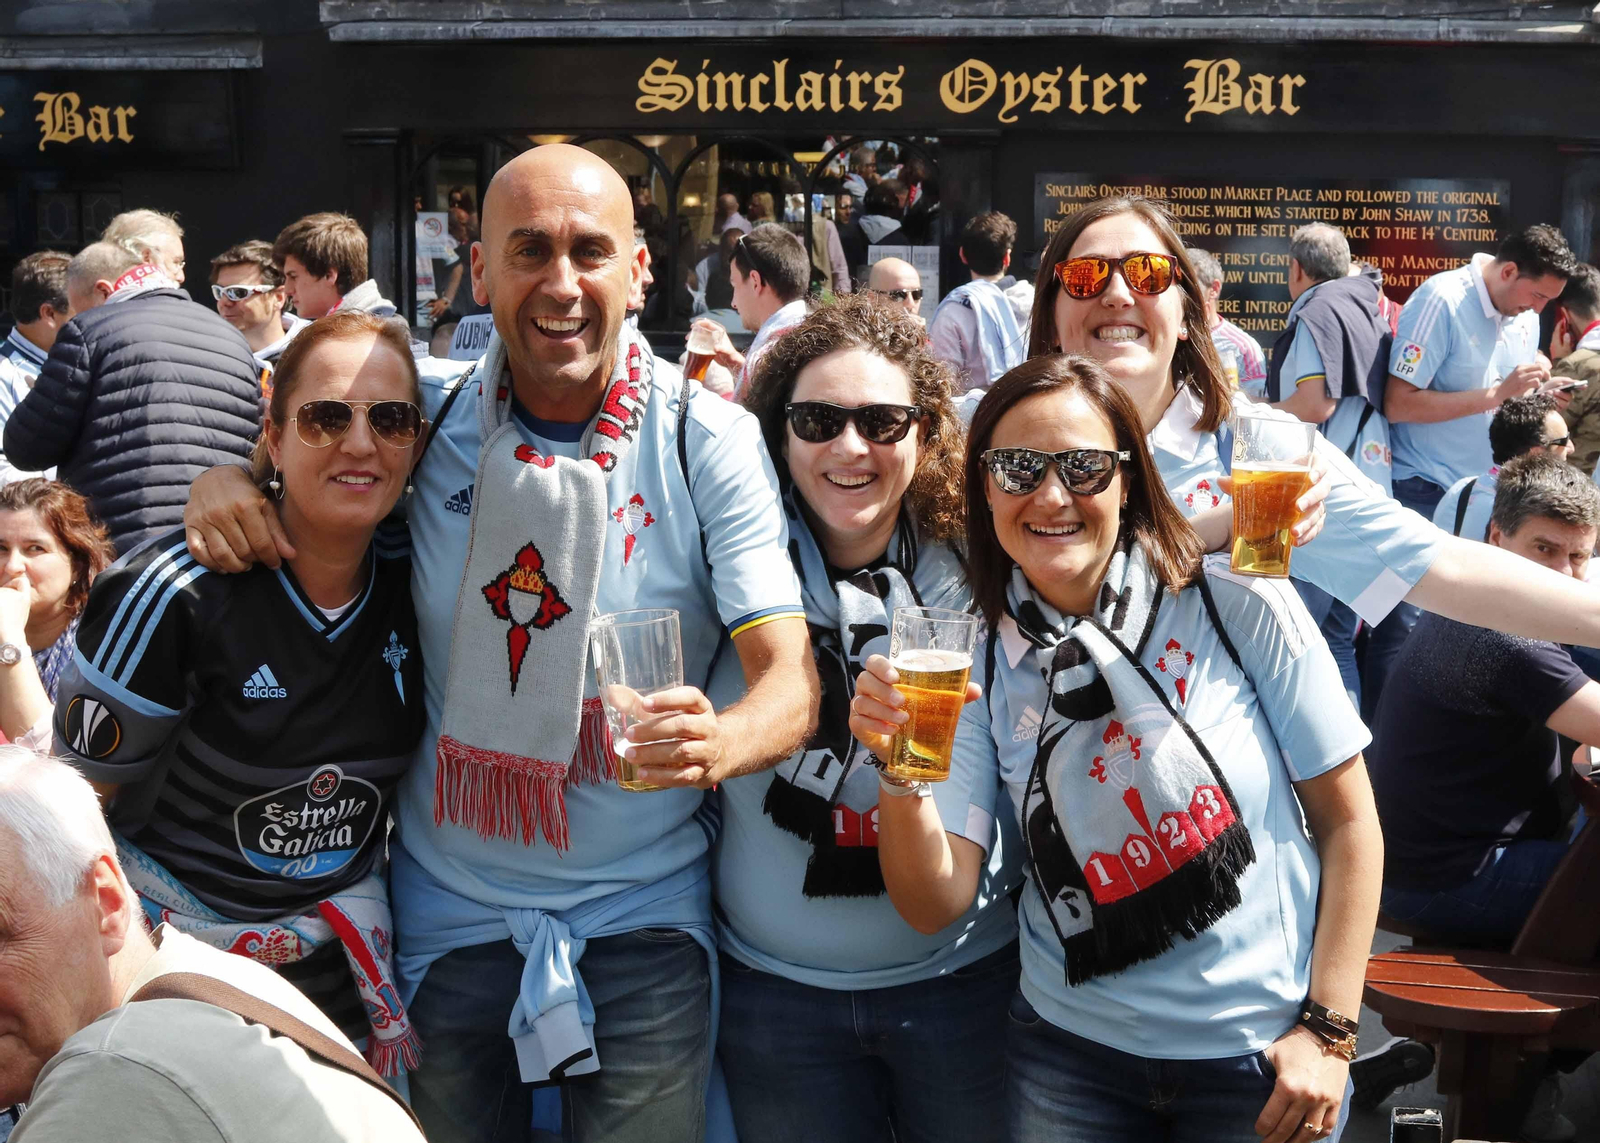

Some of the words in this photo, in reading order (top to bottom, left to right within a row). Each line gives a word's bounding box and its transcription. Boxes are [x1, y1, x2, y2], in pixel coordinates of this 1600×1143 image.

[635, 57, 905, 113] Sinclairs
[939, 58, 1148, 124] Oyster
[1183, 57, 1307, 124] Bar
[33, 91, 138, 152] Bar
[1099, 184, 1142, 199] OYSTER
[1144, 184, 1168, 199] BAR
[1171, 186, 1207, 200] STOOD
[1210, 187, 1222, 200] IN
[1224, 185, 1273, 201] MARKET
[1276, 186, 1313, 201] PLACE
[1316, 189, 1342, 202] AND
[1345, 190, 1411, 204] FOLLOWED
[1416, 190, 1439, 205] THE
[1443, 191, 1501, 206] ORIGINAL
[1255, 206, 1281, 219] WAS
[1285, 206, 1339, 220] STARTED
[1342, 207, 1358, 221] BY
[1359, 206, 1392, 222] JOHN
[1394, 207, 1434, 223] SHAW
[1437, 209, 1451, 223] IN
[1215, 223, 1232, 236] ON
[1236, 223, 1258, 237] THE
[1261, 224, 1286, 238] SITE
[1375, 226, 1392, 239] TO
[1394, 226, 1418, 240] THE
[1224, 252, 1257, 266] FIRST
[1381, 256, 1395, 269] IN
[1248, 271, 1287, 285] UNTIL
[1397, 274, 1413, 287] AT
[1216, 300, 1241, 313] ERE
[1396, 361, 1414, 375] LFP
[444, 499, 472, 516] adid
[242, 685, 288, 699] adidas
[1012, 724, 1040, 743] adid
[260, 797, 367, 831] Estrella
[258, 823, 353, 857] Galicia
